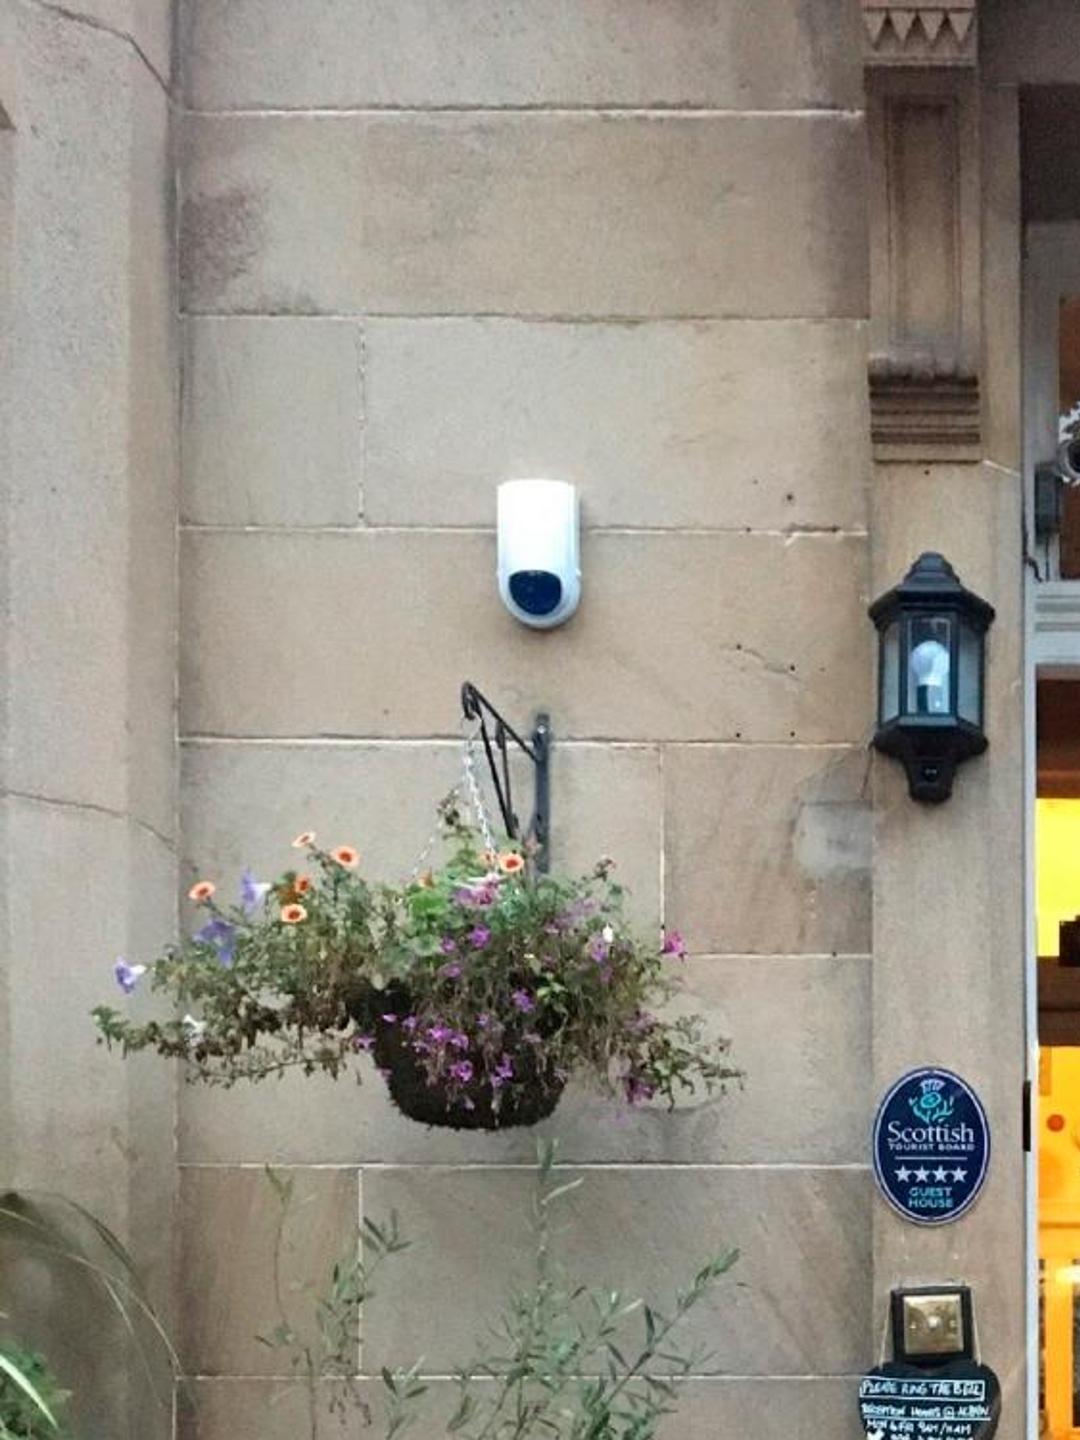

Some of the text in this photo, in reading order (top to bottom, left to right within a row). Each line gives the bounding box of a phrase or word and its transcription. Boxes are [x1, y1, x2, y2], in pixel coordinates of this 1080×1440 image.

[888, 1120, 975, 1143] Scottish
[889, 1143, 975, 1151] TOURIST BOARD
[909, 1187, 952, 1197] GUEST
[909, 1198, 953, 1208] HOUSE
[862, 1380, 898, 1394] PLEASE
[901, 1382, 928, 1395] RING
[929, 1383, 952, 1396] THE
